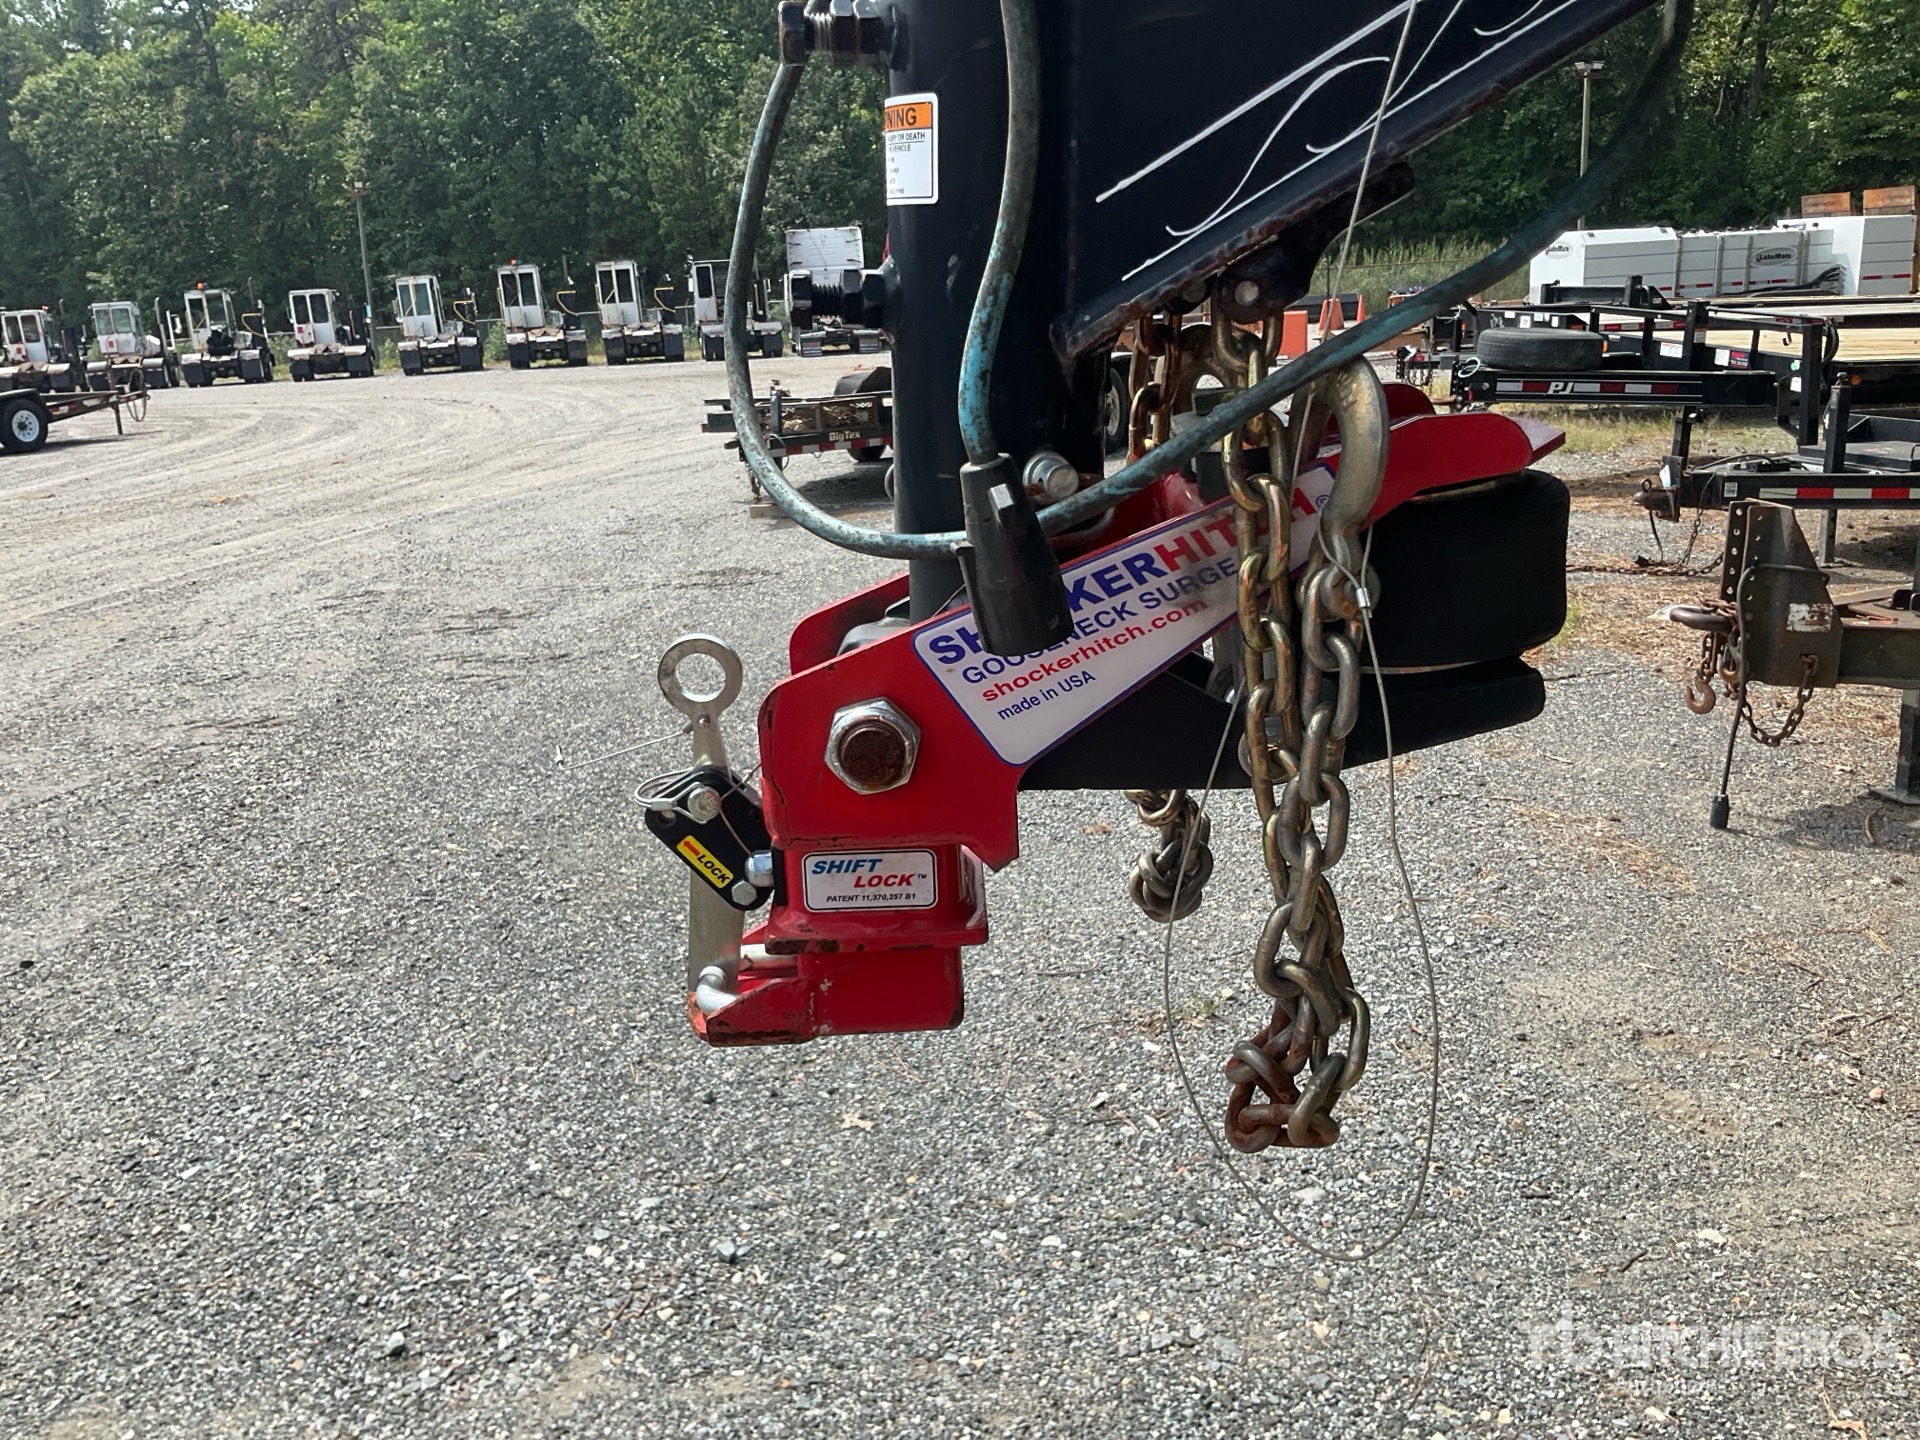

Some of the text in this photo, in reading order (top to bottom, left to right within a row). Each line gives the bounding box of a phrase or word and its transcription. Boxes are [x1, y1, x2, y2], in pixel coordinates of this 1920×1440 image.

[906, 132, 925, 140] DEATH
[1547, 381, 1574, 395] PJ
[1138, 557, 1240, 610] SURGE
[982, 600, 1209, 701] shockerhitch.com
[997, 670, 1096, 720] made in USA
[696, 854, 731, 884] LOCK
[811, 858, 882, 875] SHIFT
[853, 873, 916, 888] LOCK
[826, 894, 859, 903] PATENT
[861, 893, 904, 902] 11,370,257
